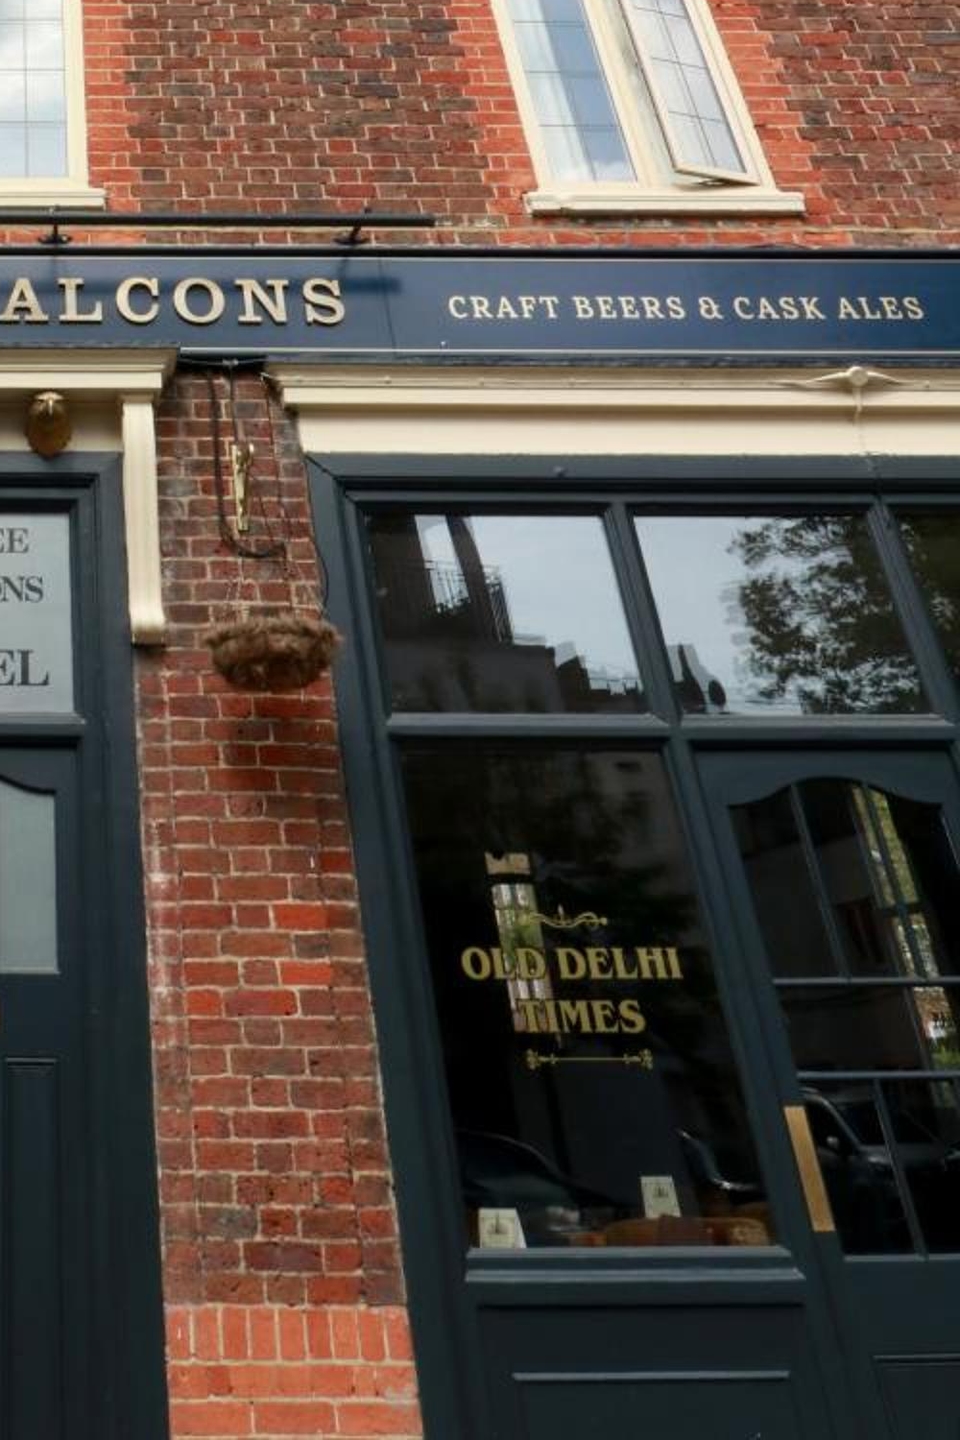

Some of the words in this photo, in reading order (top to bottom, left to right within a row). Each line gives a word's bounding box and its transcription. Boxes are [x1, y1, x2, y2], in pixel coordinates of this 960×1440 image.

[447, 295, 559, 320] CRAFT
[572, 295, 687, 320] BEERS
[698, 296, 725, 320] &
[733, 296, 826, 320] CASK
[837, 296, 925, 320] ALES
[460, 946, 547, 981] OLD
[558, 946, 684, 981] DELHI
[518, 1000, 646, 1034] TIMES
